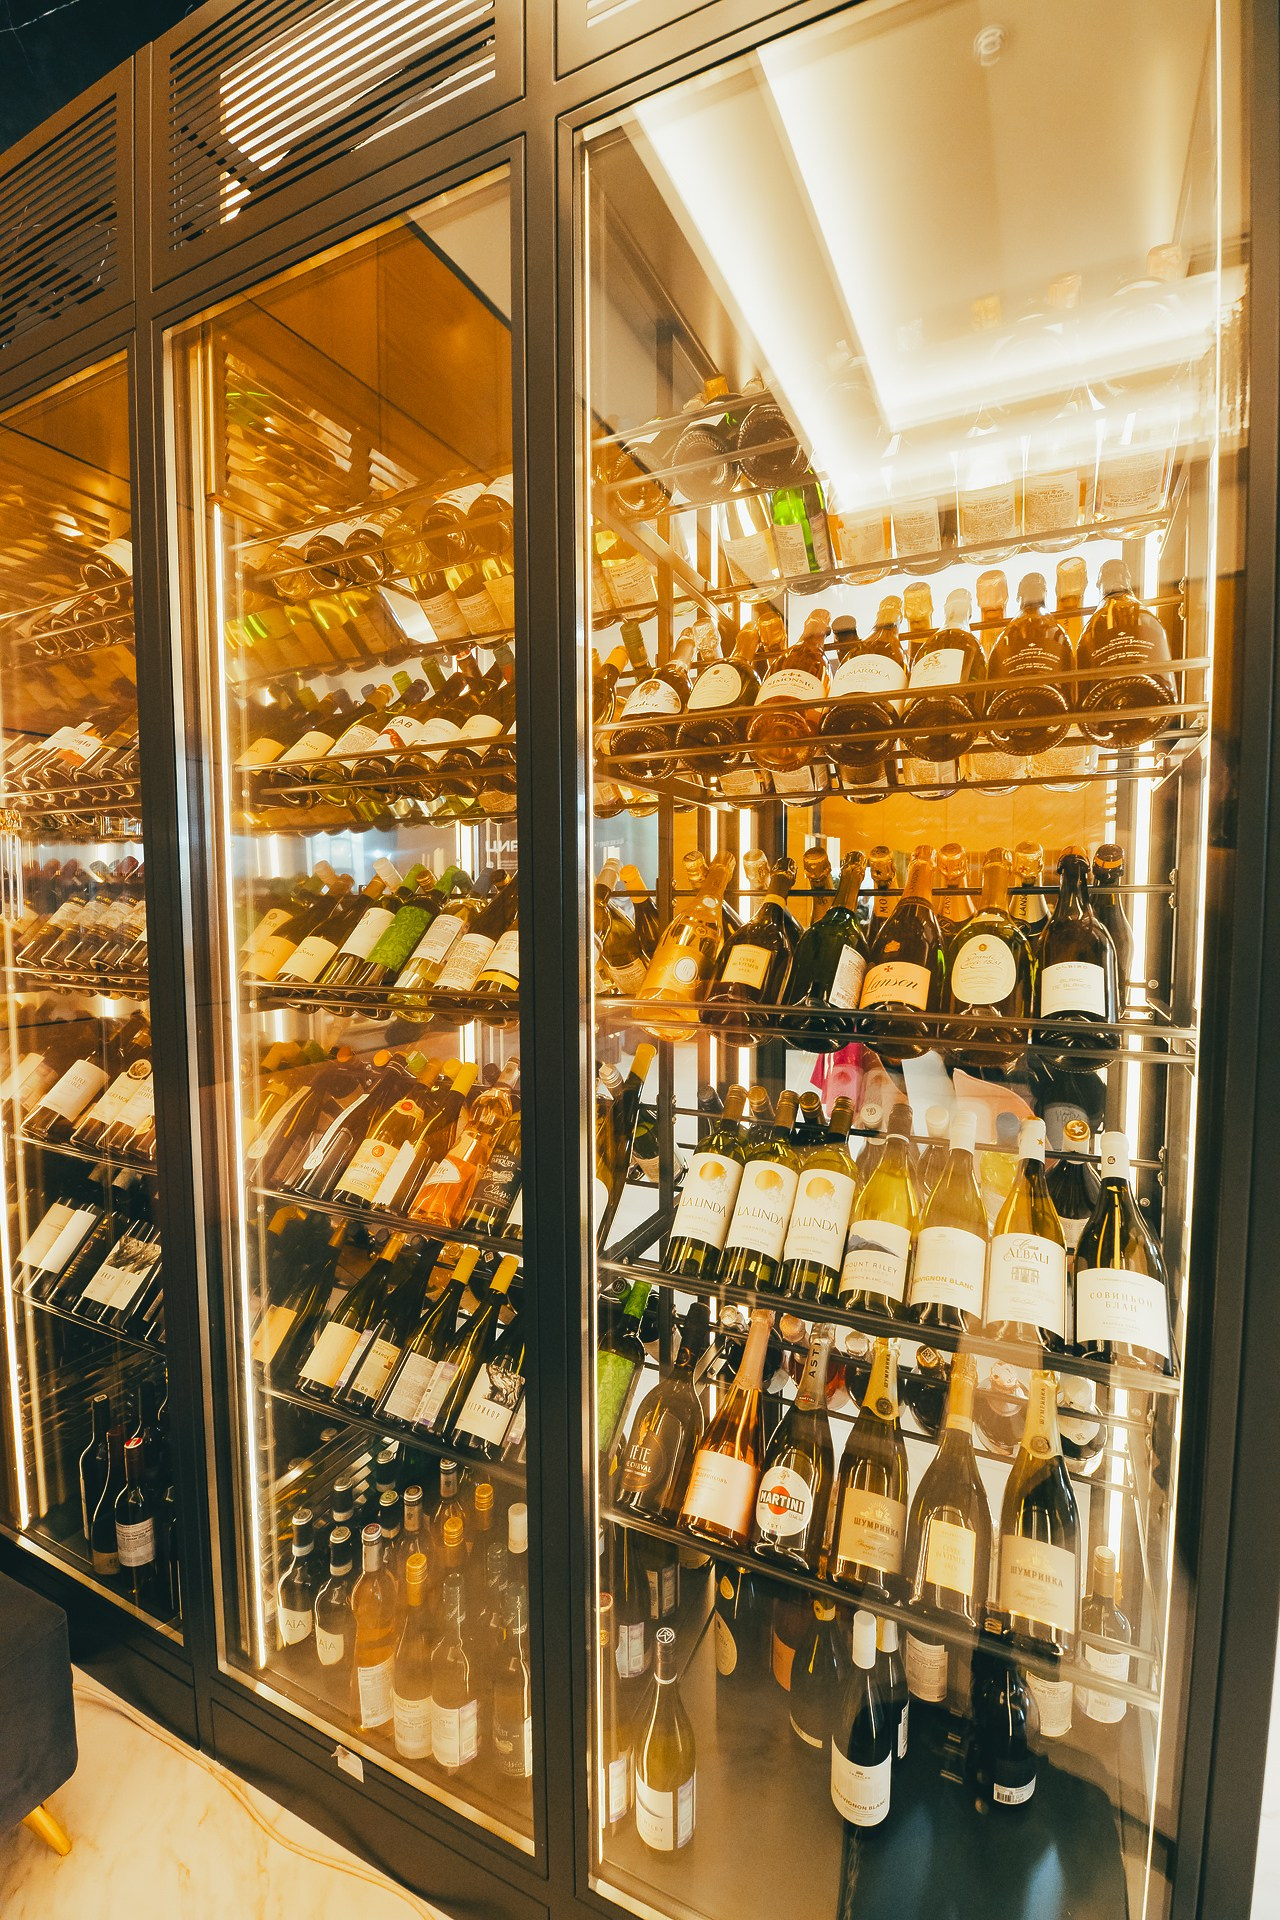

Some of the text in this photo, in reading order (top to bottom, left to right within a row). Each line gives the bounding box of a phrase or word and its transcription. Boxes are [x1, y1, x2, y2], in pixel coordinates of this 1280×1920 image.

[864, 972, 919, 995] Lanson
[681, 1196, 727, 1218] LA LINDA
[737, 1205, 785, 1229] LA LINDA
[790, 1215, 839, 1236] LA LINDA
[1003, 1247, 1050, 1265] ALBALI
[872, 1262, 898, 1275] RILEY
[949, 1278, 976, 1292] BLANC
[1105, 1301, 1138, 1313] БЛАН
[808, 1341, 821, 1379] ASTI
[760, 1490, 804, 1514] MARTINI
[853, 1516, 900, 1539] ШУМРИНКА
[1010, 1565, 1064, 1588] ШУМРИНКА
